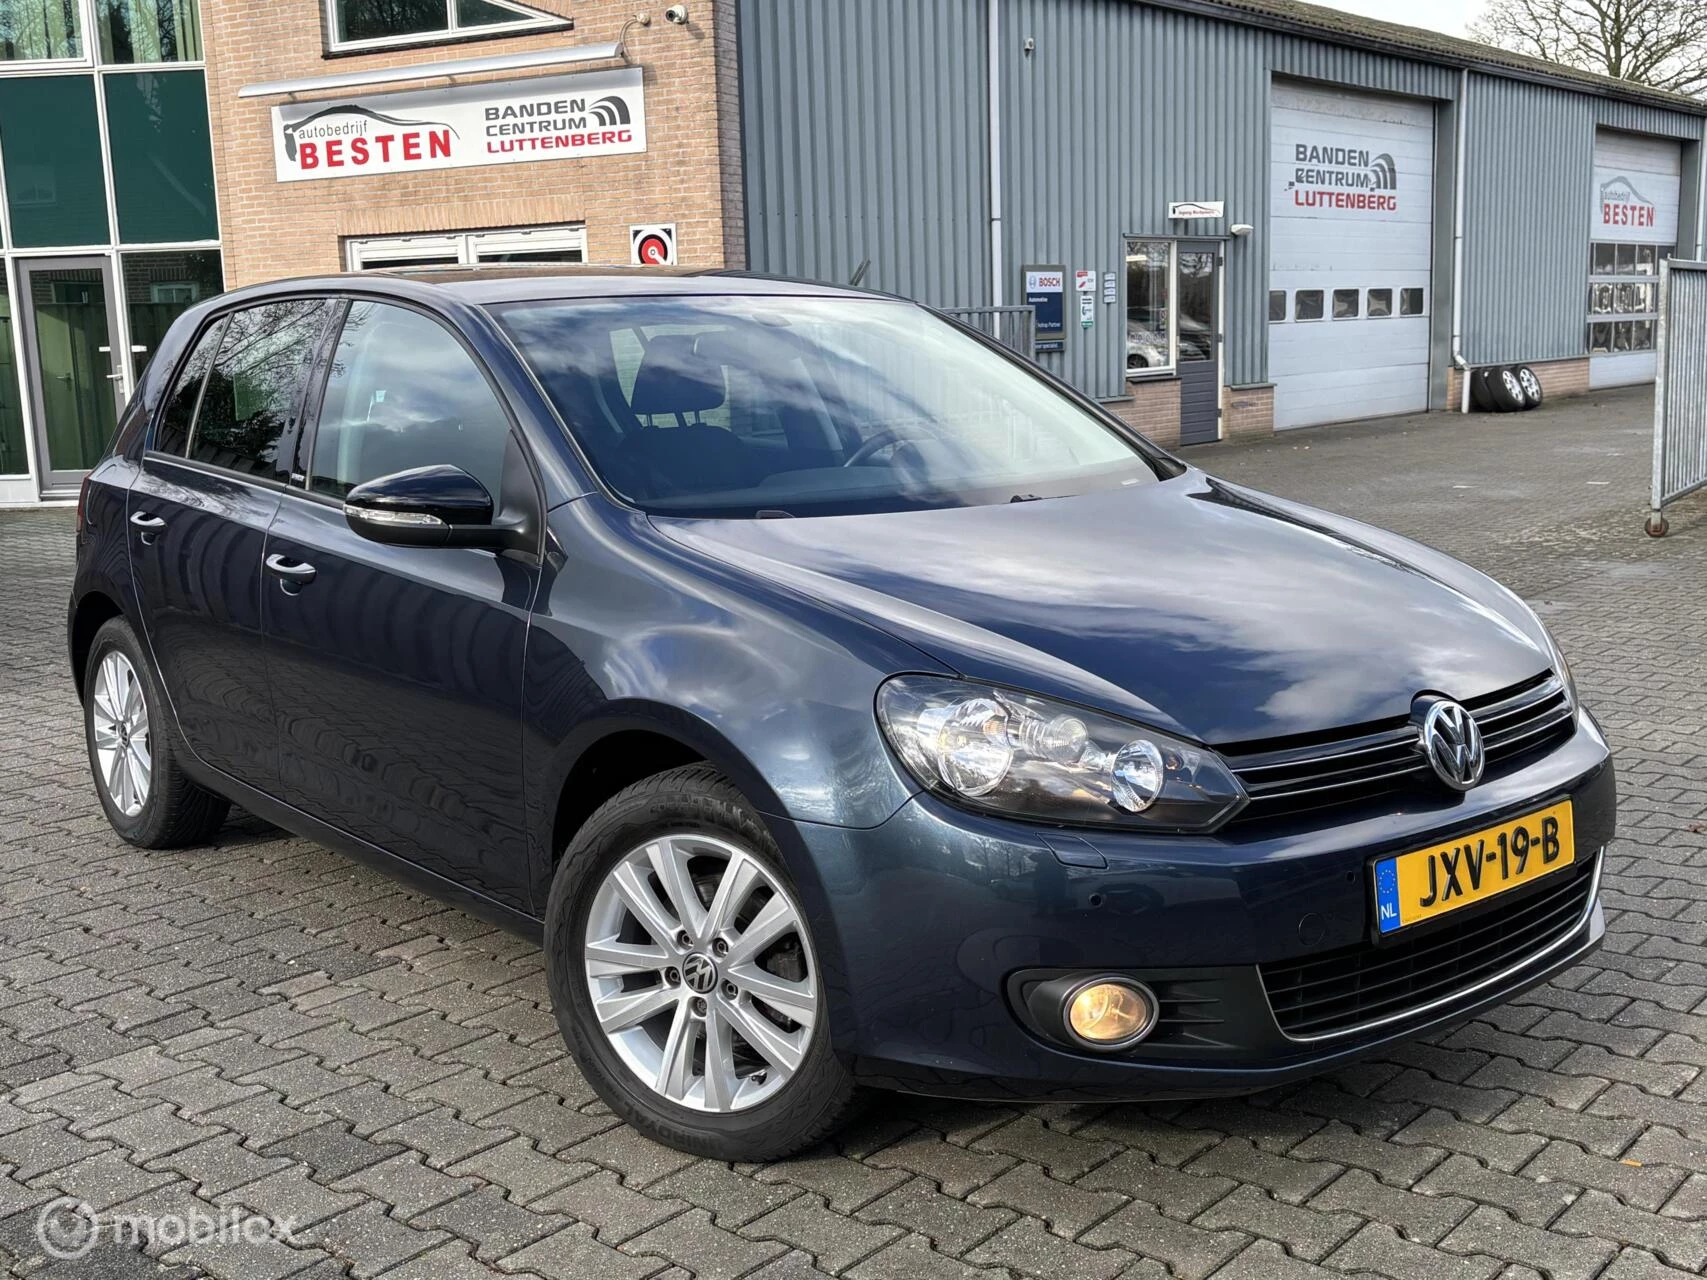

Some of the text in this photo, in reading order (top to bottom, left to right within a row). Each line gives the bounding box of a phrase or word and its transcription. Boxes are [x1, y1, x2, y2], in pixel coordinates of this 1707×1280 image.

[485, 98, 586, 121] BANDEN
[298, 119, 367, 139] autobedrijf
[486, 117, 587, 137] CENTRUM
[300, 129, 451, 170] BESTEN
[487, 129, 632, 154] LUTTENBERG
[1295, 143, 1369, 167] BANDEN
[1295, 168, 1369, 188] CENTRUM
[1294, 190, 1396, 211] LUTTENBERG
[1603, 203, 1654, 227] BESTEN
[1039, 277, 1060, 287] BOSCH
[1420, 816, 1560, 907] JXV-19-B
[1381, 903, 1397, 920] NL
